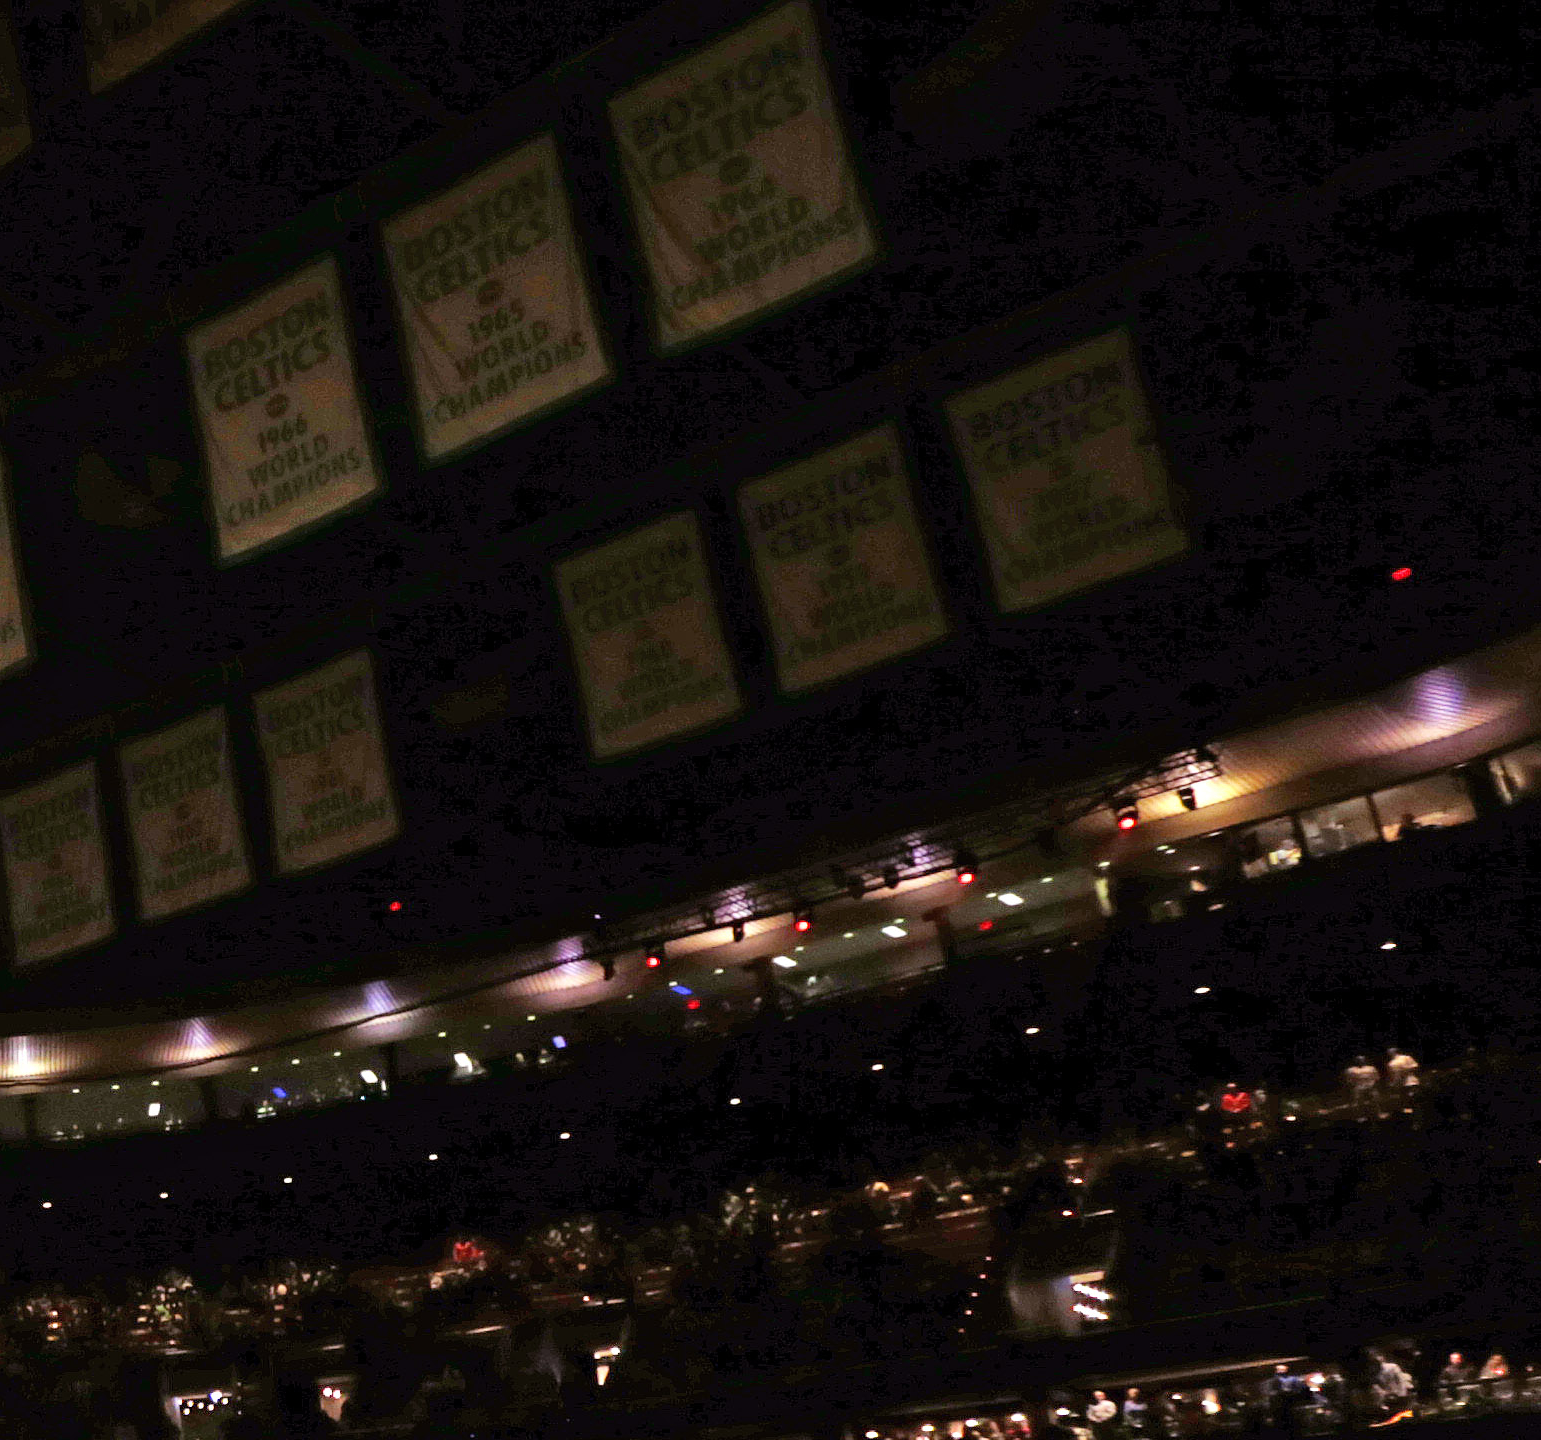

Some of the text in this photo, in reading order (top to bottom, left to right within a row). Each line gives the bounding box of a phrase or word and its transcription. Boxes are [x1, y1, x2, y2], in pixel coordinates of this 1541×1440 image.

[630, 31, 803, 151] BOSTON
[650, 77, 807, 183] CELTICS
[403, 168, 548, 272] BOSTON
[416, 207, 549, 302] CELTICS
[695, 195, 808, 265] WORLD
[672, 205, 855, 311] CHAMPIONS
[202, 290, 329, 382] BOSTON
[455, 320, 549, 381] WORLD
[467, 298, 525, 345] 1965
[214, 329, 330, 411] CELTICS
[434, 330, 587, 424] CHAMPIONS
[968, 363, 1122, 442] BOSTON
[247, 433, 329, 489] WORLD
[257, 412, 308, 454] 1966
[984, 393, 1125, 474] CELTICS
[226, 446, 362, 527] CHAMPIONS
[756, 455, 892, 532] BOSTON
[769, 487, 896, 559] CELTICS
[570, 537, 692, 607] BOSTON
[583, 568, 693, 633] CELTICS
[267, 675, 363, 733] BOSTON
[277, 703, 365, 758] CELTICS
[133, 732, 221, 784] BOSTON
[140, 757, 219, 809] CELTICS
